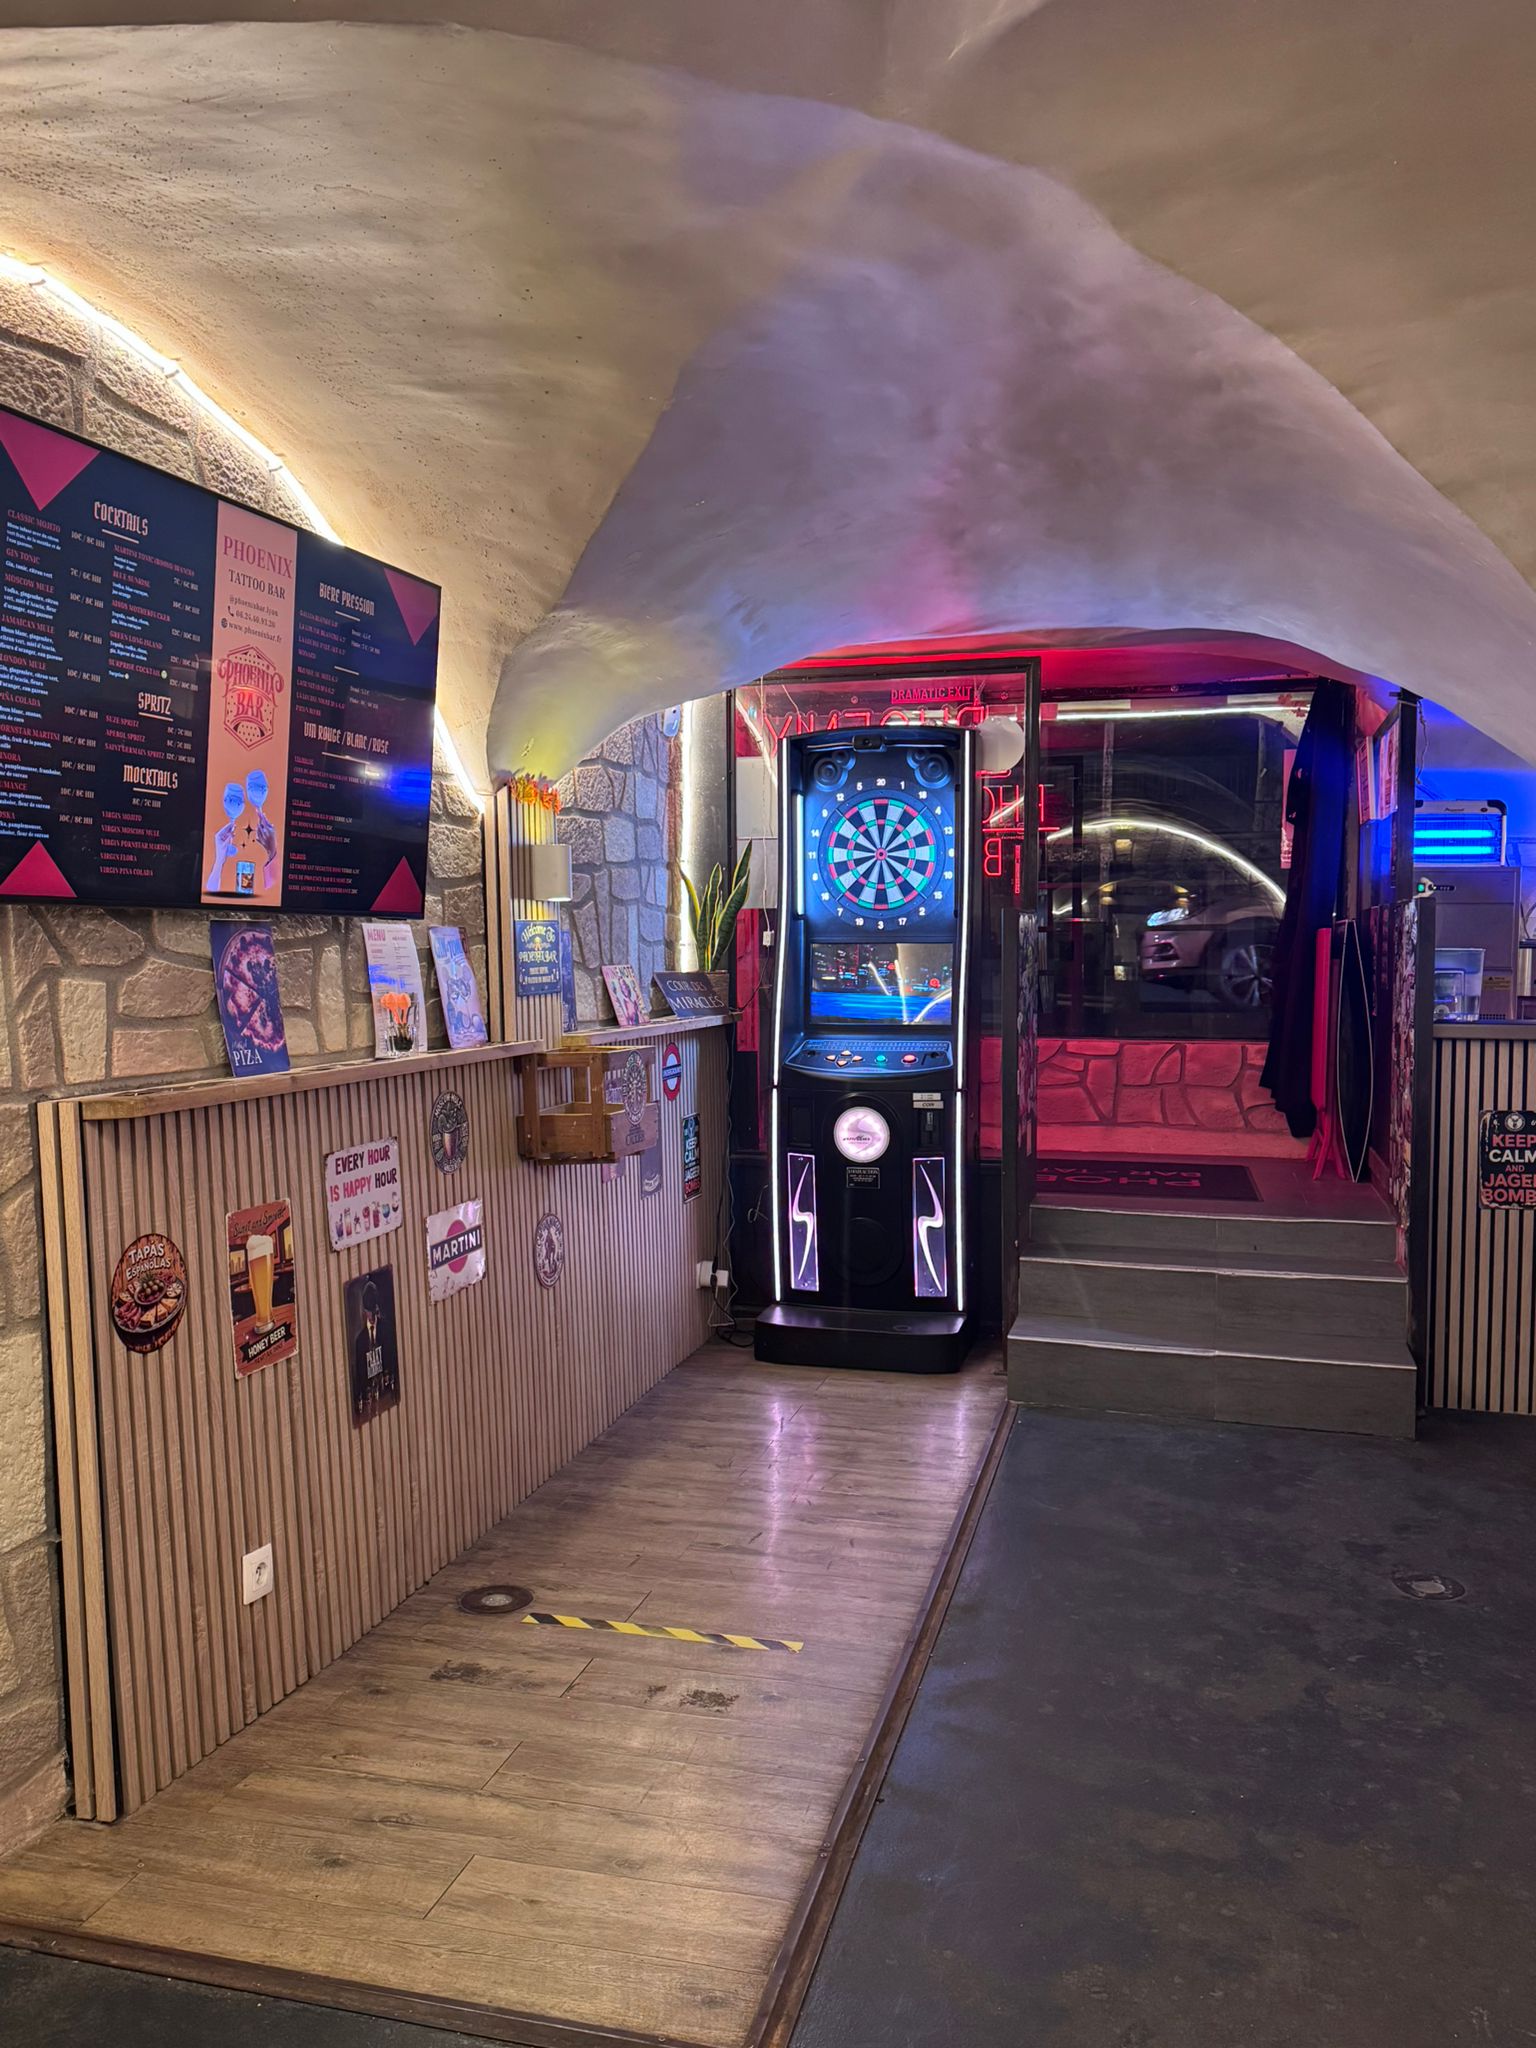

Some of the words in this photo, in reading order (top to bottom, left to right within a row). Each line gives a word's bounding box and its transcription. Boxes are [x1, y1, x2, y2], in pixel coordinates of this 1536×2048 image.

[94, 501, 149, 536] COCKTAILS
[223, 535, 292, 579] PHOENIX
[228, 569, 265, 593] TATTOO
[267, 582, 286, 600] BAR
[319, 582, 340, 603] BIERE
[341, 590, 375, 616] PRESSION
[217, 658, 284, 707] PHOENIX
[891, 687, 946, 700] DRAMATIC
[948, 686, 972, 697] EXIT
[138, 692, 172, 715] SPRITZ
[234, 691, 264, 723] BAR
[304, 721, 317, 739] VIN
[318, 725, 342, 744] ROUGE
[123, 764, 179, 789] MOCKTAILS
[856, 782, 863, 791] 5
[900, 781, 905, 790] 1
[836, 793, 845, 801] 12
[935, 806, 941, 815] 4
[811, 829, 820, 837] 14
[944, 827, 953, 835] 13
[808, 851, 816, 859] 11
[933, 891, 943, 899] 15
[837, 908, 844, 916] 7
[919, 907, 926, 916] 2
[877, 921, 884, 929] 3
[898, 918, 907, 926] 17
[367, 928, 386, 941] MENU
[690, 981, 708, 992] DES
[1492, 1134, 1536, 1148] KEEP
[335, 1151, 365, 1176] EVERY
[367, 1144, 391, 1166] HOUR
[1505, 1164, 1525, 1173] AND
[330, 1184, 340, 1203] IS
[343, 1175, 372, 1199] HAPPY
[374, 1167, 398, 1189] HOUR
[432, 1229, 481, 1264] MARTINI
[248, 1335, 269, 1358] HONEY
[269, 1326, 286, 1344] BEER
